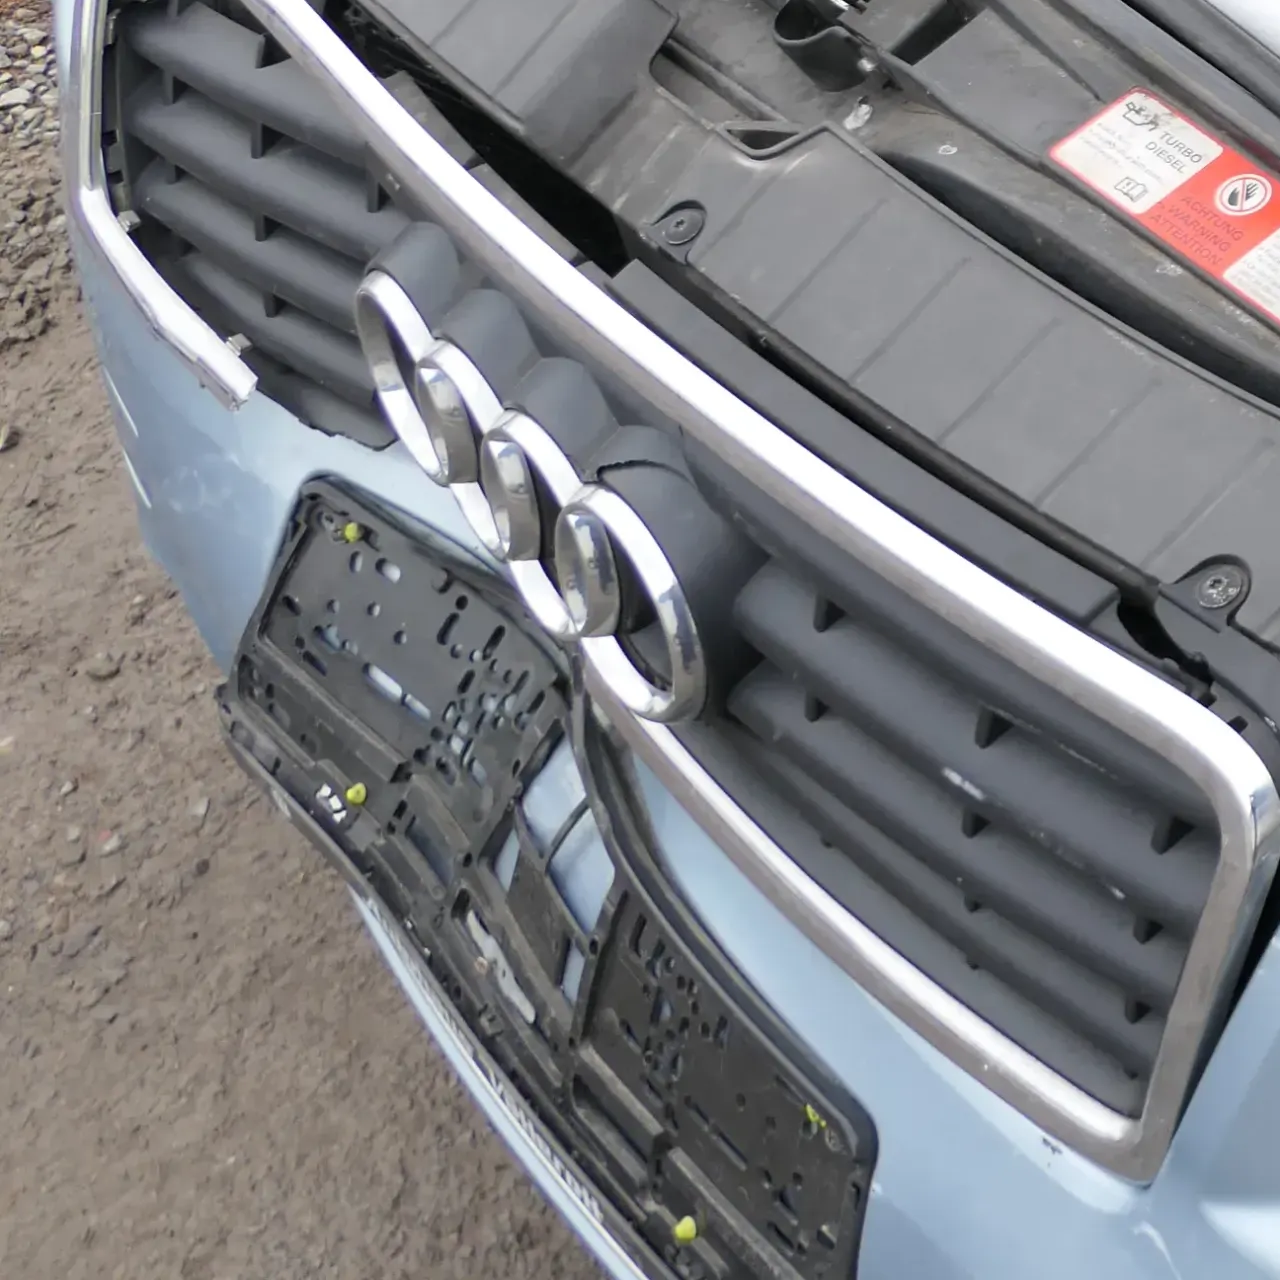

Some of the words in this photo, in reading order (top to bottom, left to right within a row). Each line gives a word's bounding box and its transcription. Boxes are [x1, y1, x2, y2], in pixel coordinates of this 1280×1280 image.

[1145, 141, 1187, 175] DIESEL
[1159, 131, 1203, 164] TURBO
[1150, 214, 1223, 265] ATTENTION
[1168, 205, 1231, 252] WARNING
[1180, 196, 1244, 241] ACHTUNG
